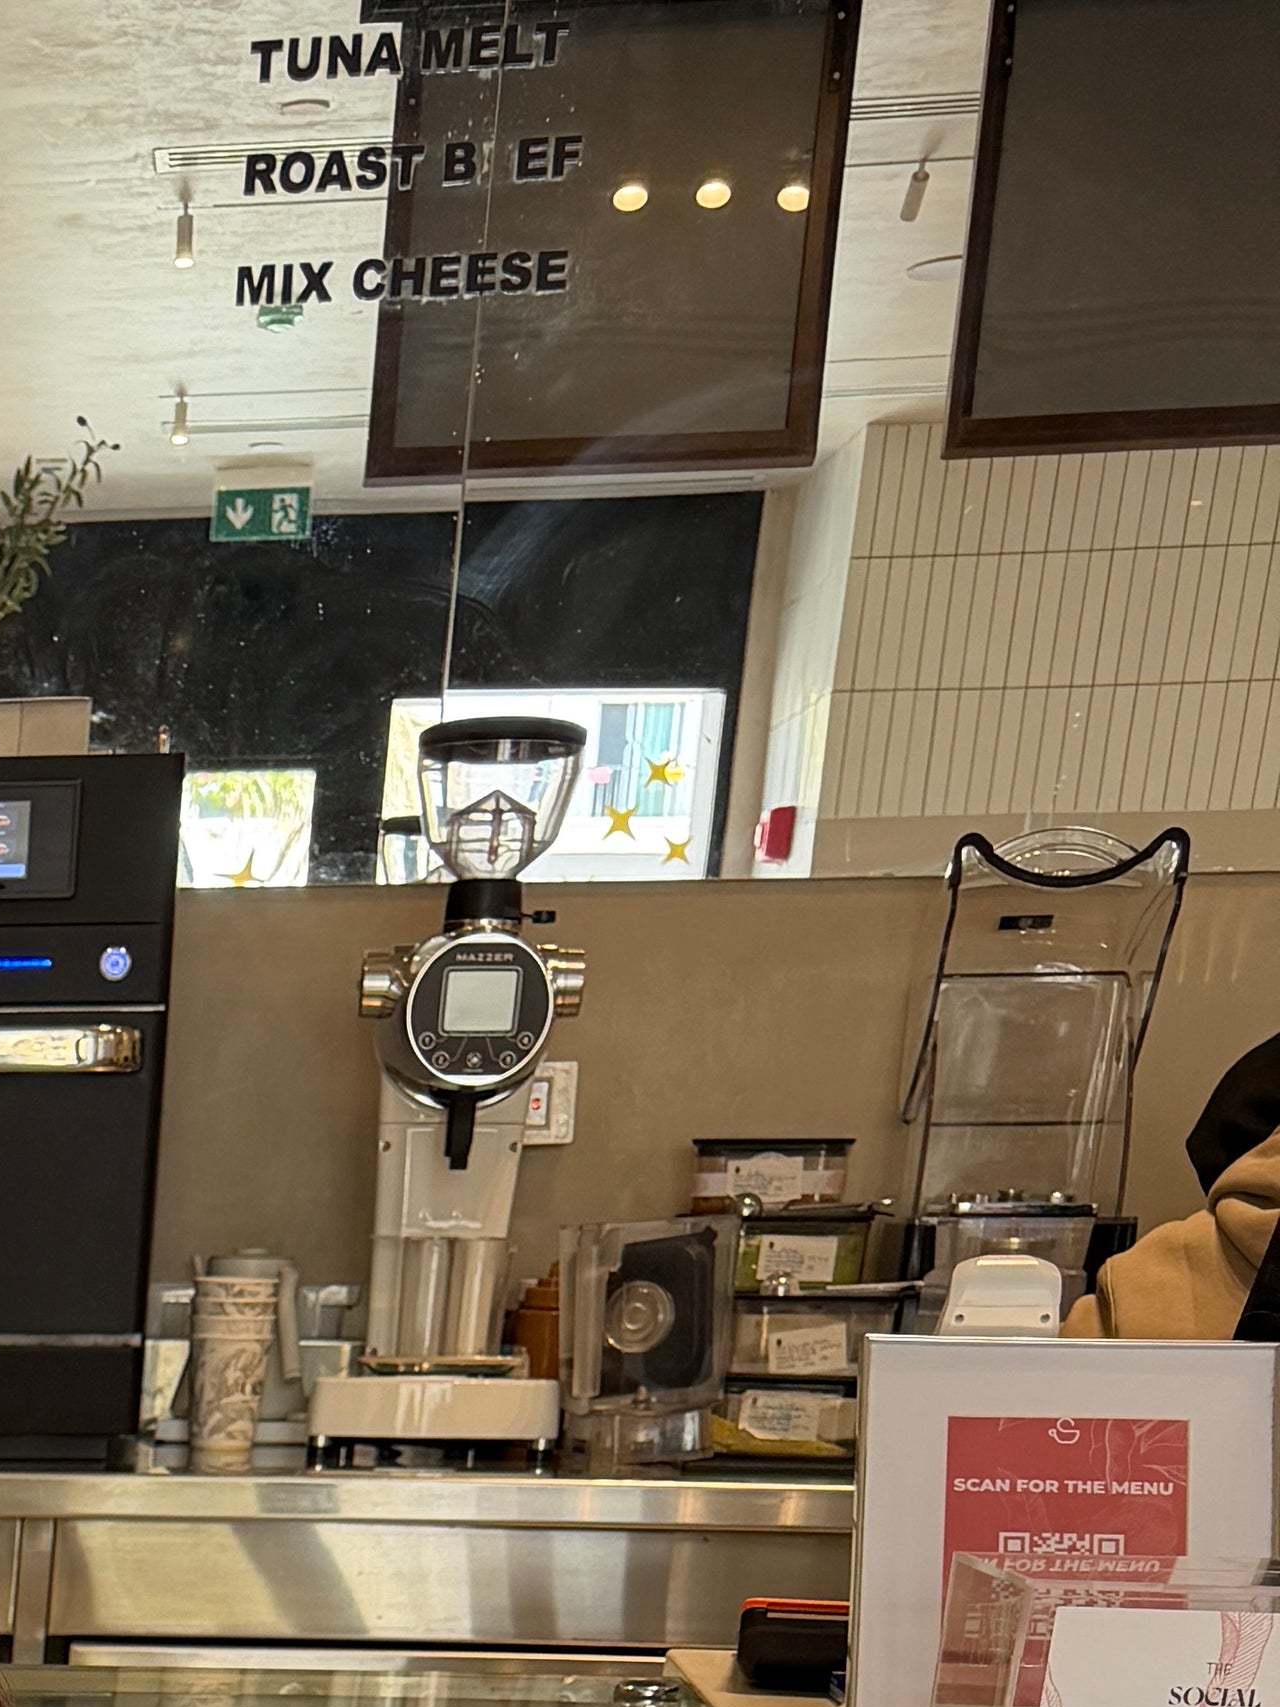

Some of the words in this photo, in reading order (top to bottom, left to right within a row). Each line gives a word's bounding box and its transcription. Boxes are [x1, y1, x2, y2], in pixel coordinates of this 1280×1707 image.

[250, 32, 403, 84] TUNA
[421, 21, 570, 74] MELT
[243, 144, 425, 196] ROAST
[235, 261, 333, 306] MIX
[352, 250, 569, 300] CHEESE
[455, 952, 515, 962] MAZZER
[953, 1478, 1010, 1492] SCAN
[1016, 1479, 1059, 1493] FOR
[1064, 1480, 1106, 1494] THE
[1110, 1481, 1174, 1496] MENU
[1206, 1662, 1233, 1675] THE
[1168, 1686, 1262, 1707] SOCIAL
